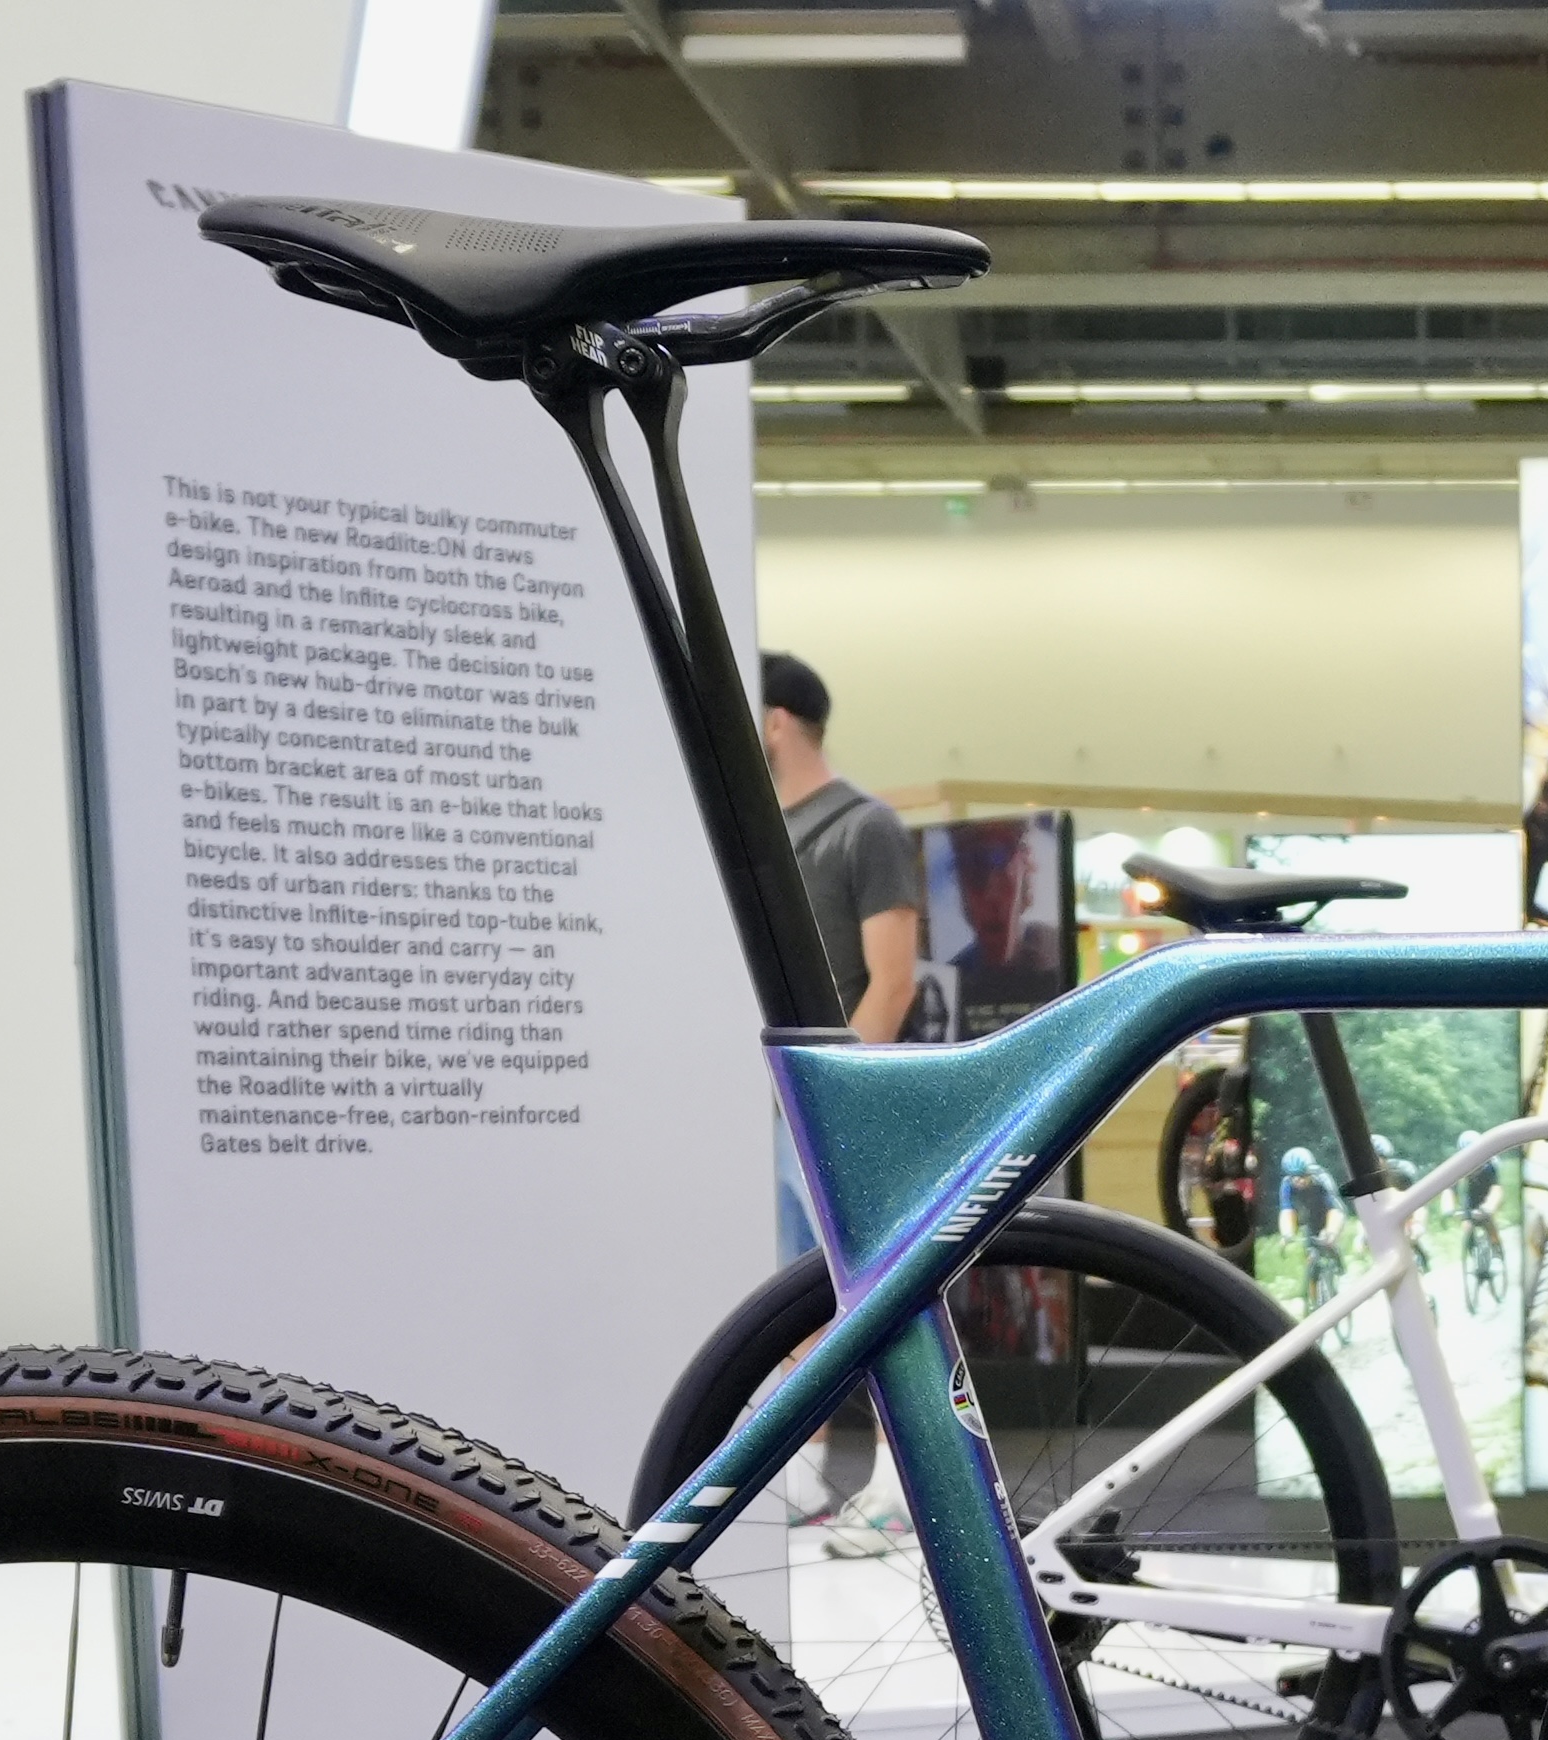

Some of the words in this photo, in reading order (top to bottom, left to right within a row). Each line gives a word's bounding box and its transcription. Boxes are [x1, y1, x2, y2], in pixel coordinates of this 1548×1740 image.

[574, 324, 605, 348] FLIP
[570, 335, 609, 368] HEAD
[163, 475, 212, 501] This
[217, 484, 236, 505] is
[242, 490, 279, 510] not
[283, 496, 332, 516] your
[336, 499, 409, 524] typical
[415, 505, 470, 536] bulky
[475, 517, 578, 541] commuter
[165, 509, 241, 535] e-bike.
[247, 515, 289, 541] The
[294, 526, 340, 545] new
[472, 541, 534, 565] draws
[193, 1017, 261, 1039] would
[267, 1019, 332, 1039] rather
[338, 1021, 400, 1045] spend
[406, 1021, 452, 1041] time
[457, 1022, 515, 1048] riding
[519, 1022, 563, 1042] than
[196, 1046, 324, 1074] maintaining
[328, 1048, 378, 1069] their
[384, 1049, 432, 1072] bike,
[438, 1049, 496, 1069] we've
[500, 1050, 589, 1074] equipped
[197, 1074, 233, 1096] the
[239, 1075, 326, 1097] Roadlite
[331, 1077, 378, 1097] with
[384, 1082, 396, 1097] a
[400, 1077, 483, 1102] virtually
[199, 1105, 395, 1128] maintenance-free,
[400, 1104, 581, 1125] carbon-reinforced
[200, 1132, 262, 1154] Gates
[268, 1133, 310, 1155] belt
[315, 1133, 373, 1154] drive.
[932, 1150, 1037, 1242] INFLITE
[121, 1486, 184, 1512] SWISS
[187, 1497, 225, 1517] DT
